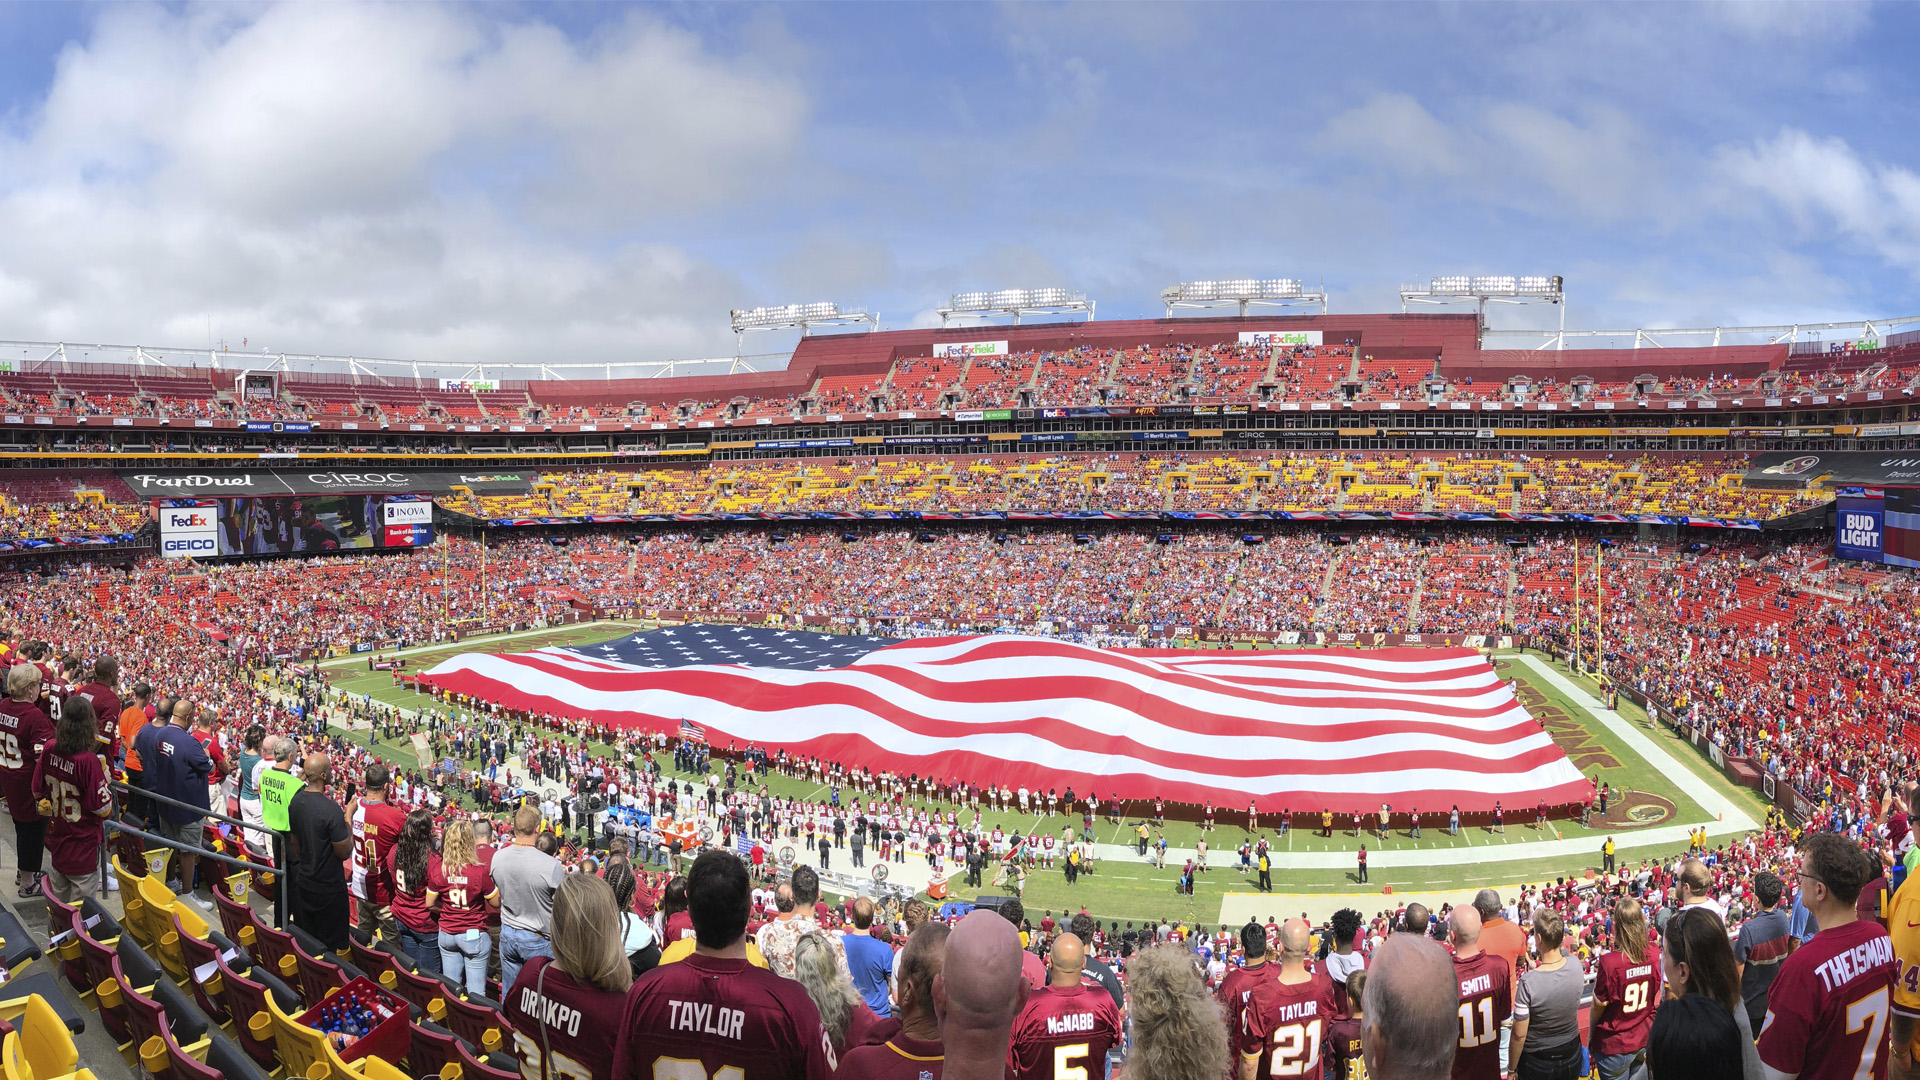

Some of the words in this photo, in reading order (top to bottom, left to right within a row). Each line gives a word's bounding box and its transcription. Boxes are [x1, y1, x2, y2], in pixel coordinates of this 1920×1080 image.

[1253, 333, 1308, 344] FedExField
[1830, 338, 1878, 353] FedExField
[946, 343, 995, 356] FedExField
[446, 380, 494, 390] FedExField
[1043, 409, 1066, 418] FedEx
[133, 474, 255, 488] FanDuel
[459, 475, 522, 484] FedExField
[396, 507, 425, 517] INOVA
[171, 514, 207, 528] FedEx
[1846, 514, 1874, 531] BUD
[164, 539, 215, 551] GEICO
[1840, 528, 1880, 547] LIGHT
[156, 740, 175, 755] USA
[49, 753, 75, 775] TAYLOR
[261, 775, 285, 791] VENDOR
[264, 789, 282, 805] 1034
[352, 835, 381, 875] 91
[1384, 886, 1392, 895] 10
[449, 888, 470, 911] 91
[1625, 965, 1652, 980] KERRIGAN
[1461, 974, 1491, 997] SMITH
[1622, 980, 1649, 1014] 91
[520, 986, 582, 1038] ORAKPO
[1279, 1000, 1318, 1022] TAYLOR
[668, 999, 746, 1041] TAYLOR
[1047, 1012, 1094, 1035] McNABB
[1458, 996, 1497, 1048] 11
[1845, 983, 1890, 1080] 7
[1270, 1019, 1322, 1076] 21
[1053, 1042, 1090, 1080] 5
